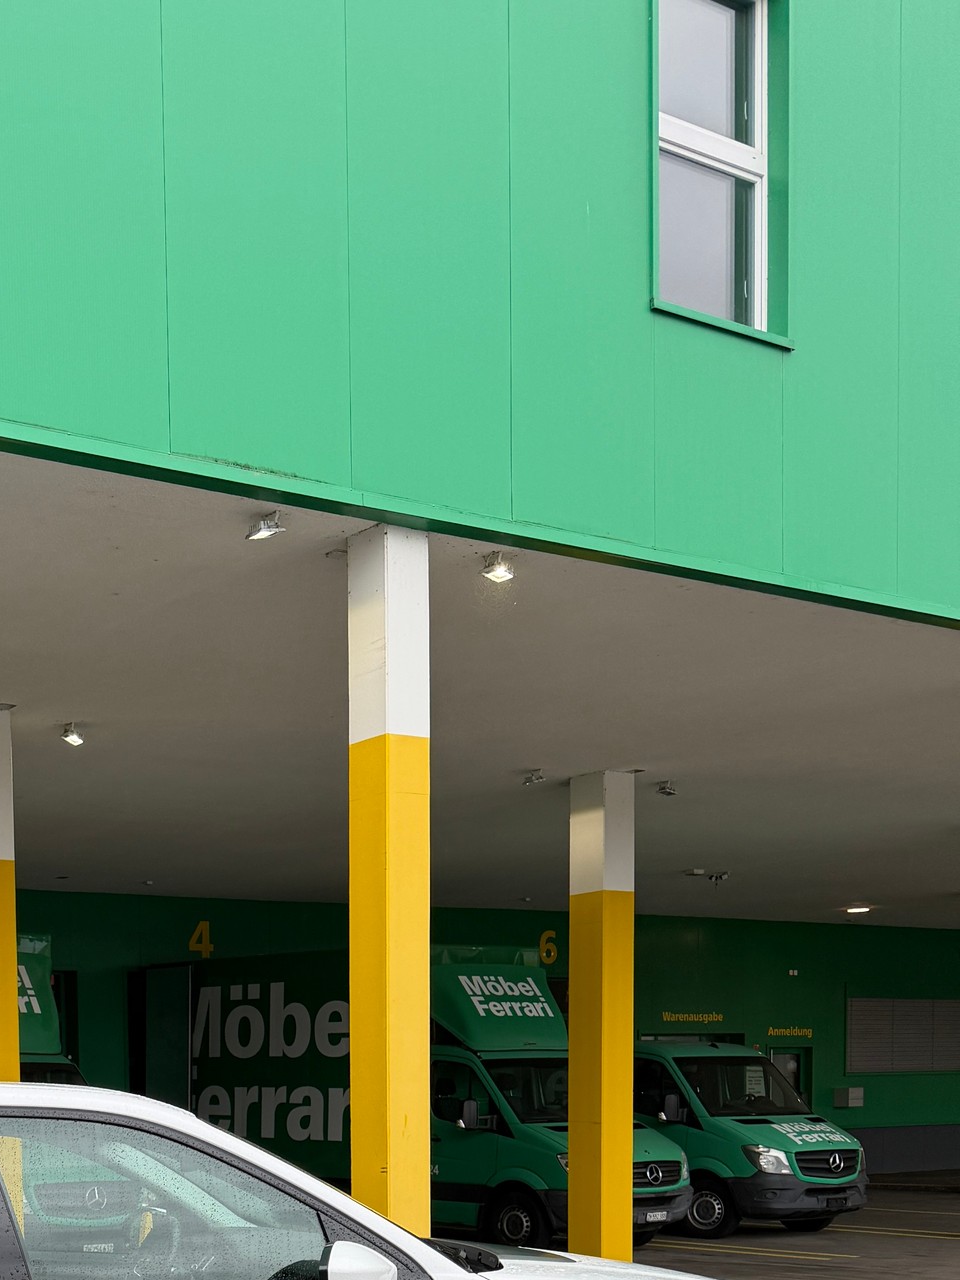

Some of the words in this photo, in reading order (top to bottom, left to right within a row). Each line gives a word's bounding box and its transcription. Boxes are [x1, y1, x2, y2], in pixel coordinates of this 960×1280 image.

[189, 920, 214, 959] 4
[540, 930, 557, 964] 6
[458, 976, 542, 997] Möbel
[193, 982, 349, 1059] Möbe
[470, 995, 555, 1018] Ferrari
[662, 1012, 724, 1023] Warenausgabe
[768, 1027, 813, 1039] Anmeldung
[192, 1065, 349, 1142] errar
